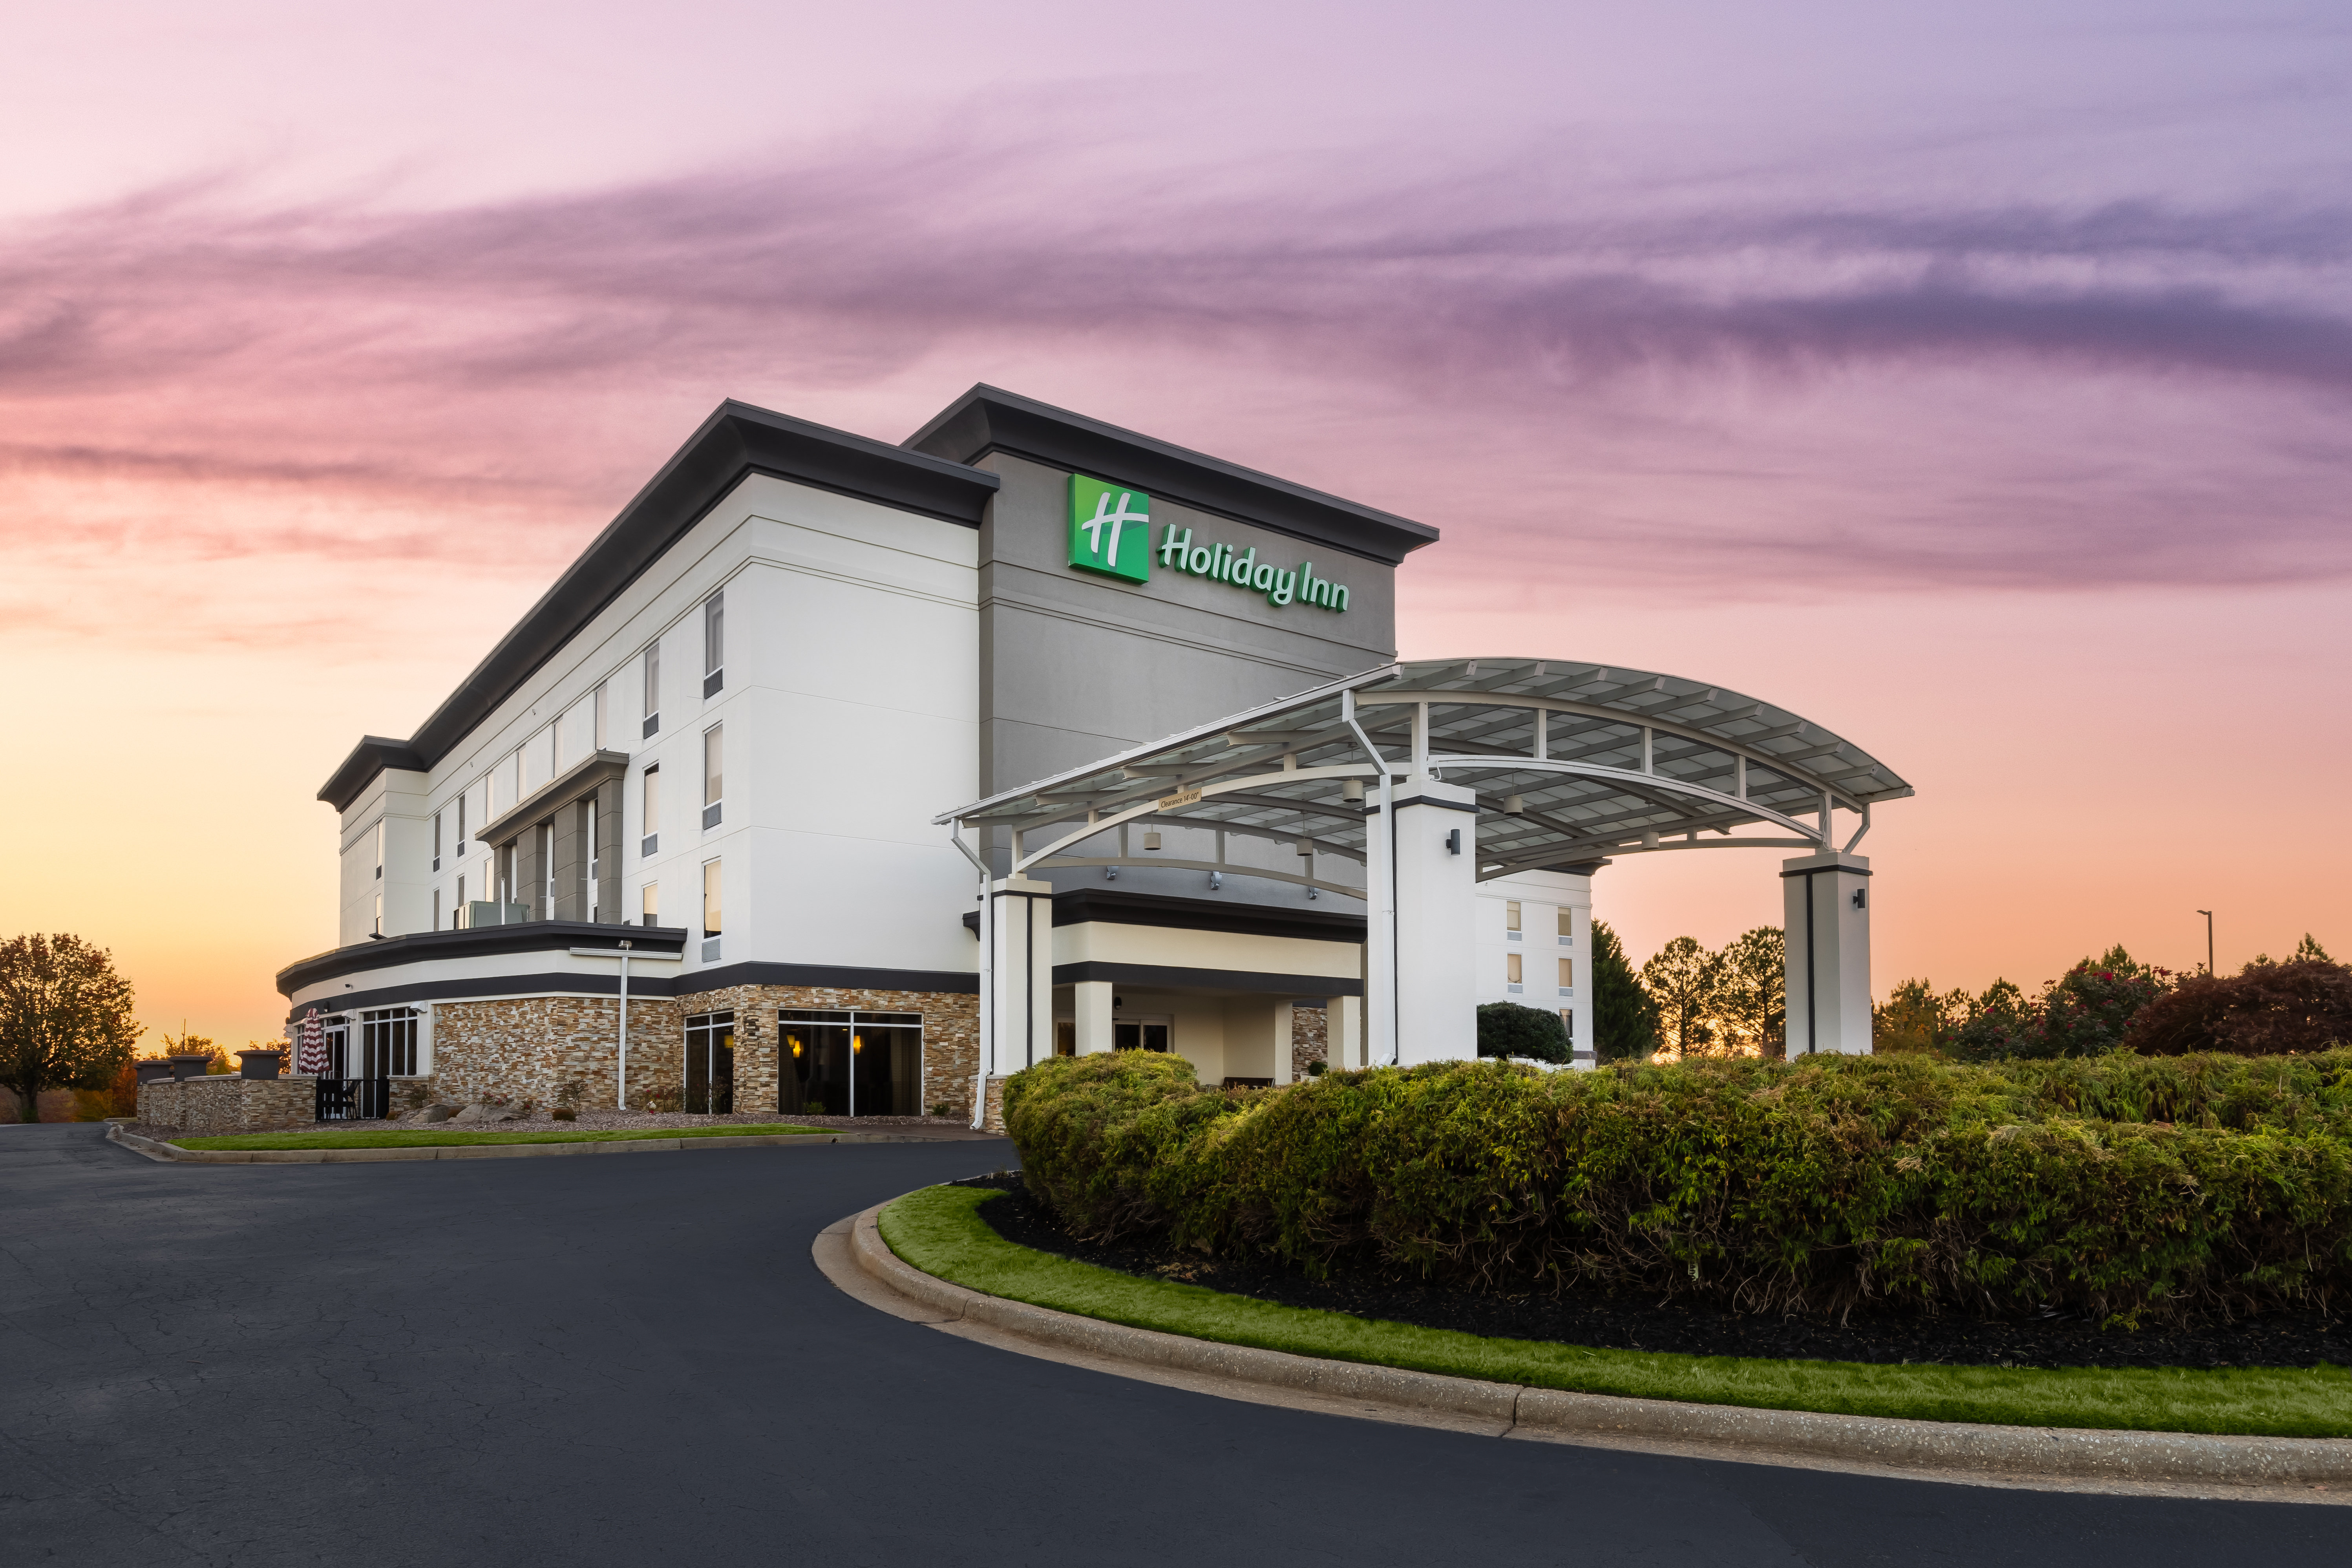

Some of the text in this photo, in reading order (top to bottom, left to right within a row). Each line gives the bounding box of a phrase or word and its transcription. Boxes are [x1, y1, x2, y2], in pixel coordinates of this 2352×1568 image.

[1157, 523, 1350, 613] Holiday Inn
[1161, 791, 1199, 808] Clearance 14'-00"
